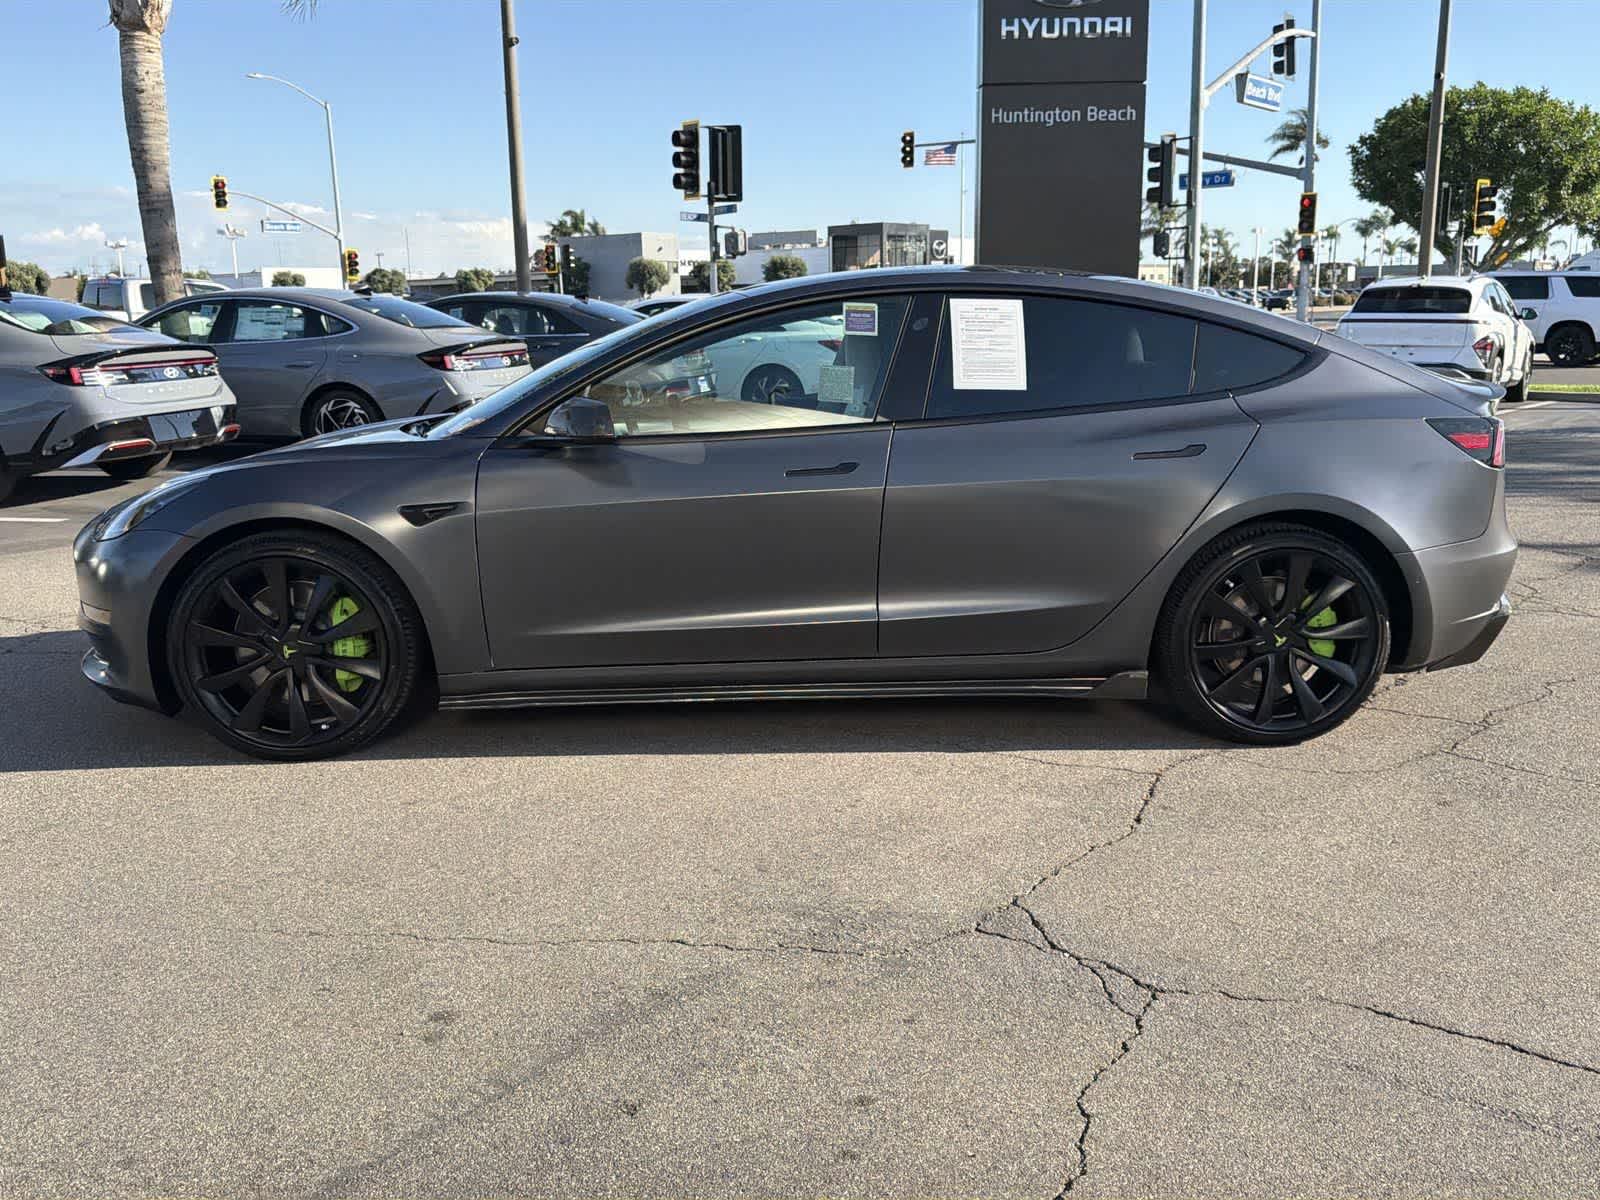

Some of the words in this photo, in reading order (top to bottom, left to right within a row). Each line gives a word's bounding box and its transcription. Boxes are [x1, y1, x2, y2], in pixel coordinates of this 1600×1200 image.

[1000, 16, 1132, 40] HYUNDAI
[1246, 81, 1266, 99] Beach
[991, 106, 1081, 127] Huntington
[1087, 106, 1137, 122] Beach
[1214, 175, 1226, 183] Dr
